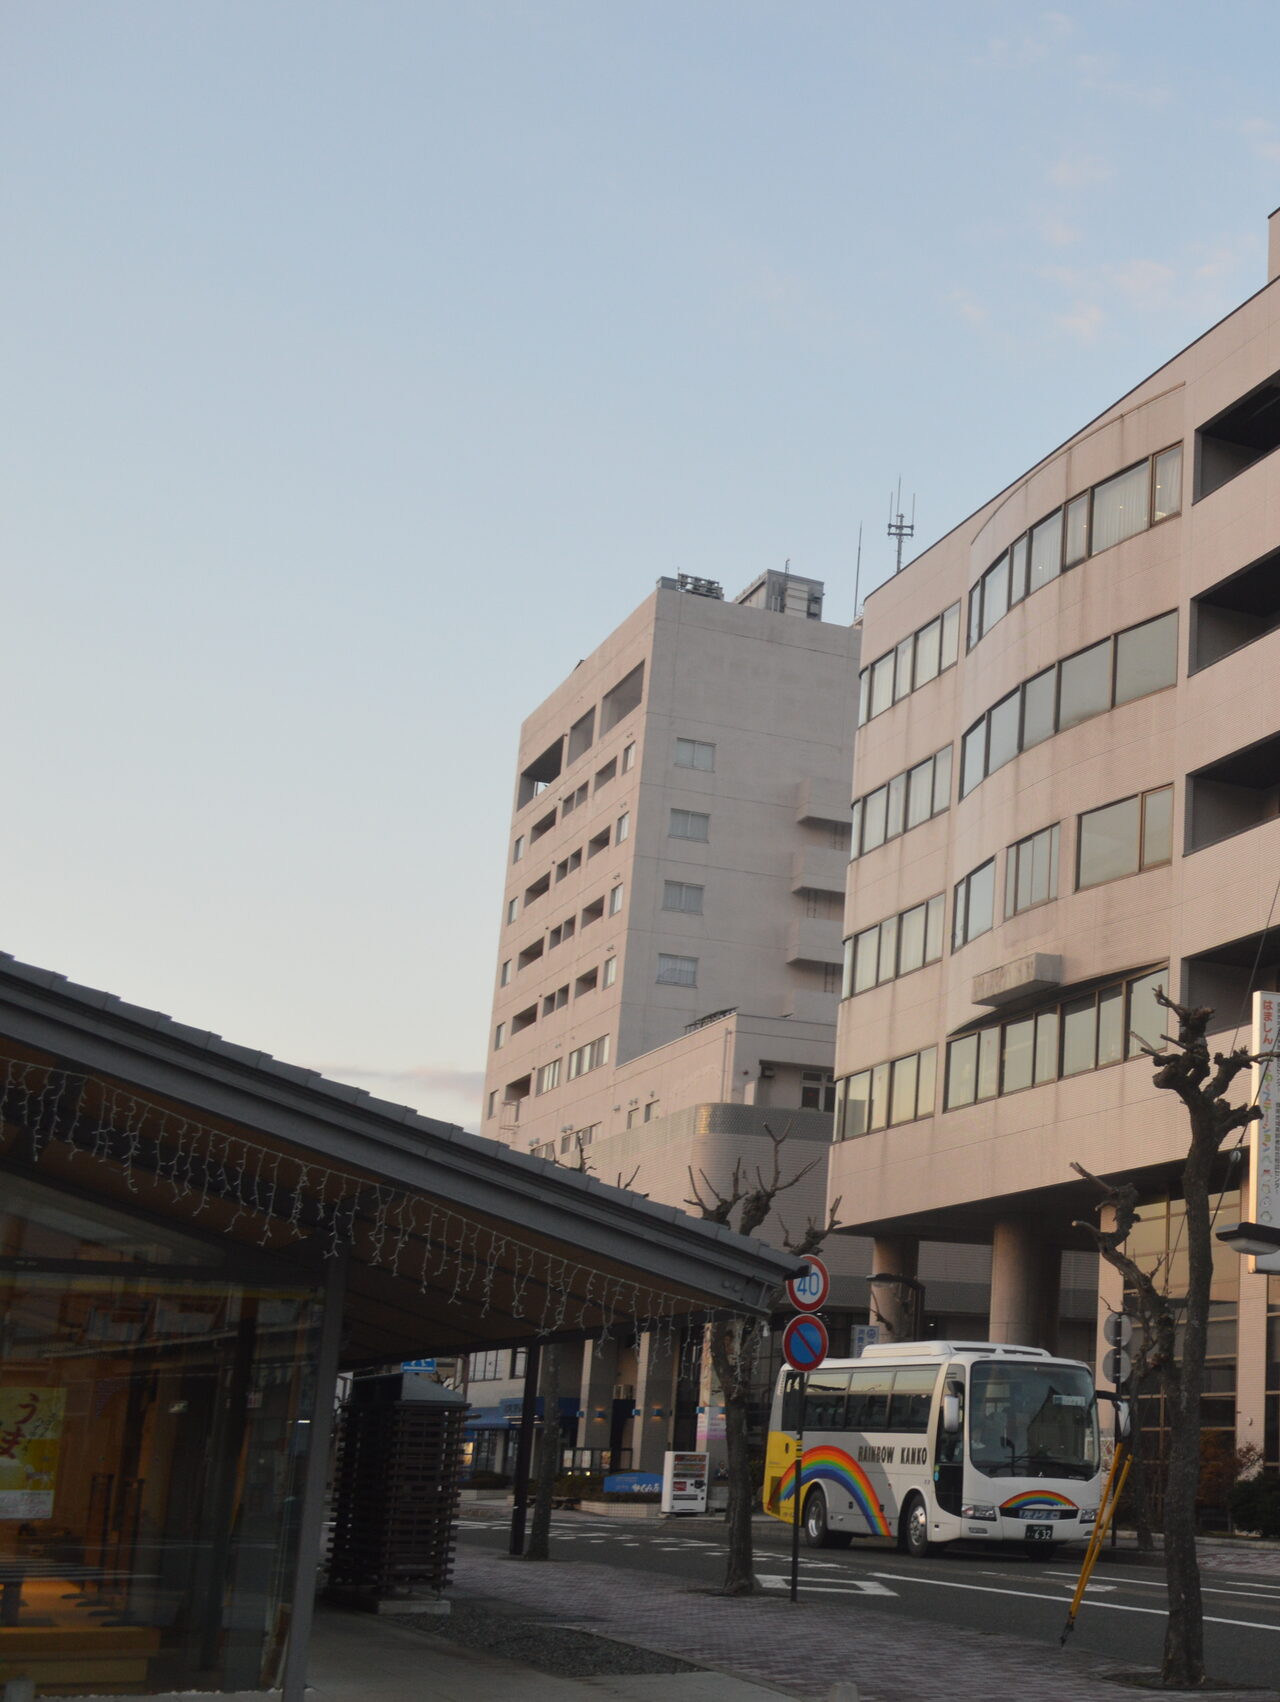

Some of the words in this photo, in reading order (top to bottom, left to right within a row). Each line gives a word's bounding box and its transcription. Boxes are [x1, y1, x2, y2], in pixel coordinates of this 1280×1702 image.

[1263, 1000, 1274, 1045] はましん
[797, 1272, 820, 1296] 40
[859, 1446, 895, 1464] RAINBOW
[900, 1446, 928, 1465] KANKO
